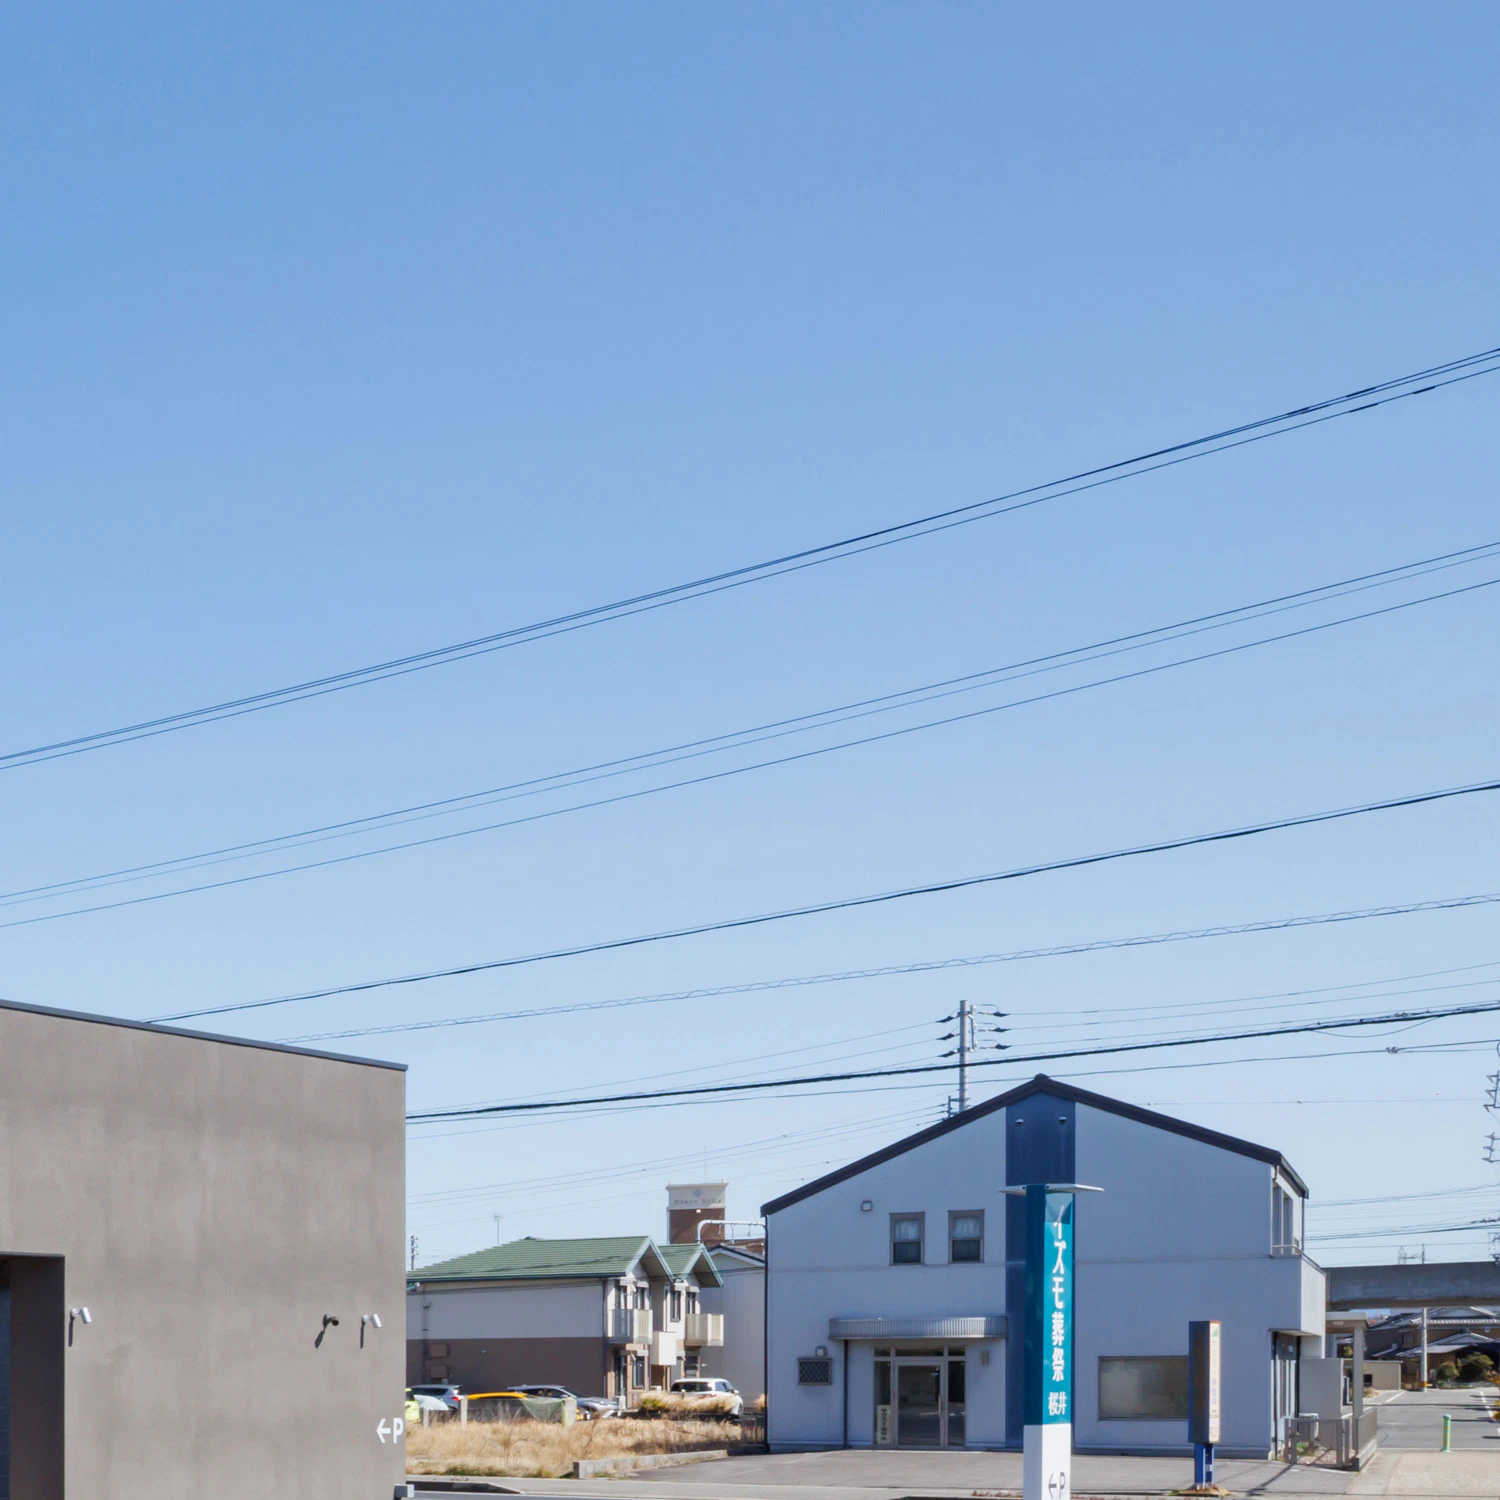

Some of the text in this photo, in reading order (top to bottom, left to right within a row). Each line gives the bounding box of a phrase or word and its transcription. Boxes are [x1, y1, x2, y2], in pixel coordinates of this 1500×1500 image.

[1052, 1205, 1067, 1382] イズモ葬祭
[1048, 1391, 1067, 1416] 桜井
[393, 1417, 404, 1444] P
[1059, 1471, 1066, 1499] P
